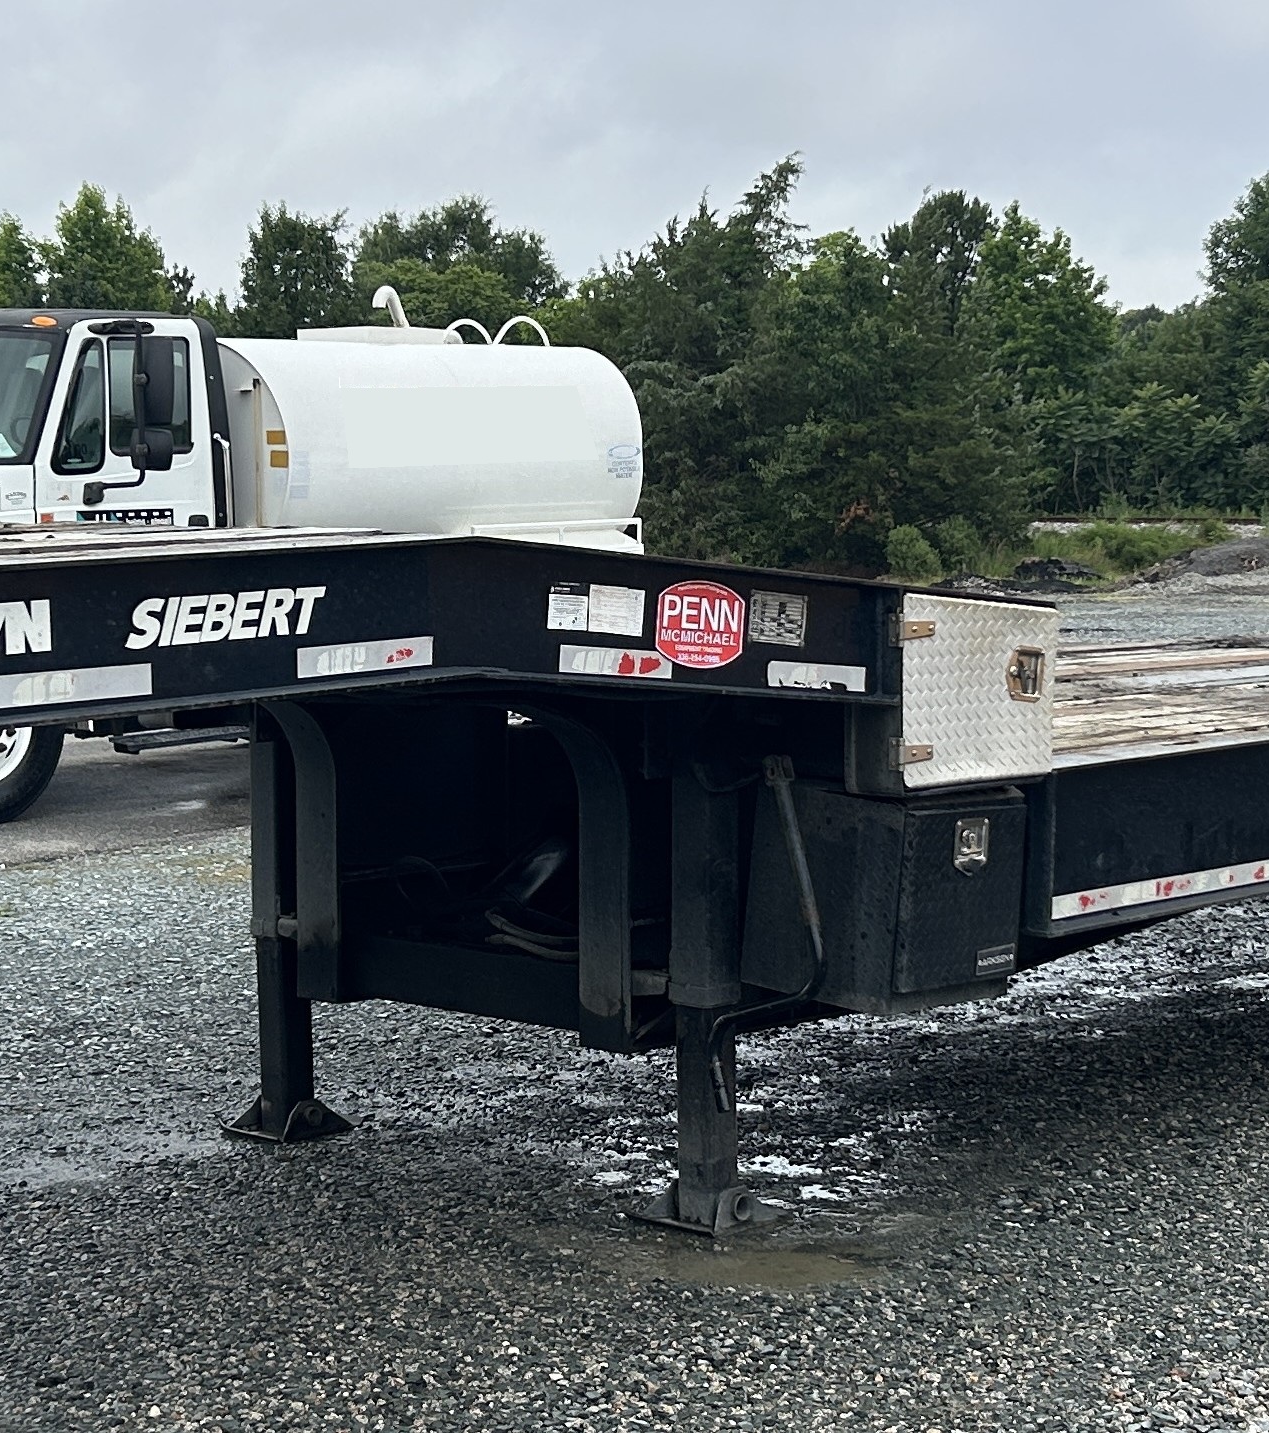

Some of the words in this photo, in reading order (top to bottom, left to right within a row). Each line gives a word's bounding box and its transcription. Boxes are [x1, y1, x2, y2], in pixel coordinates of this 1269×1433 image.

[125, 586, 326, 650] SIEBERT
[662, 594, 740, 633] PENN
[660, 628, 738, 646] MCMICHAEL
